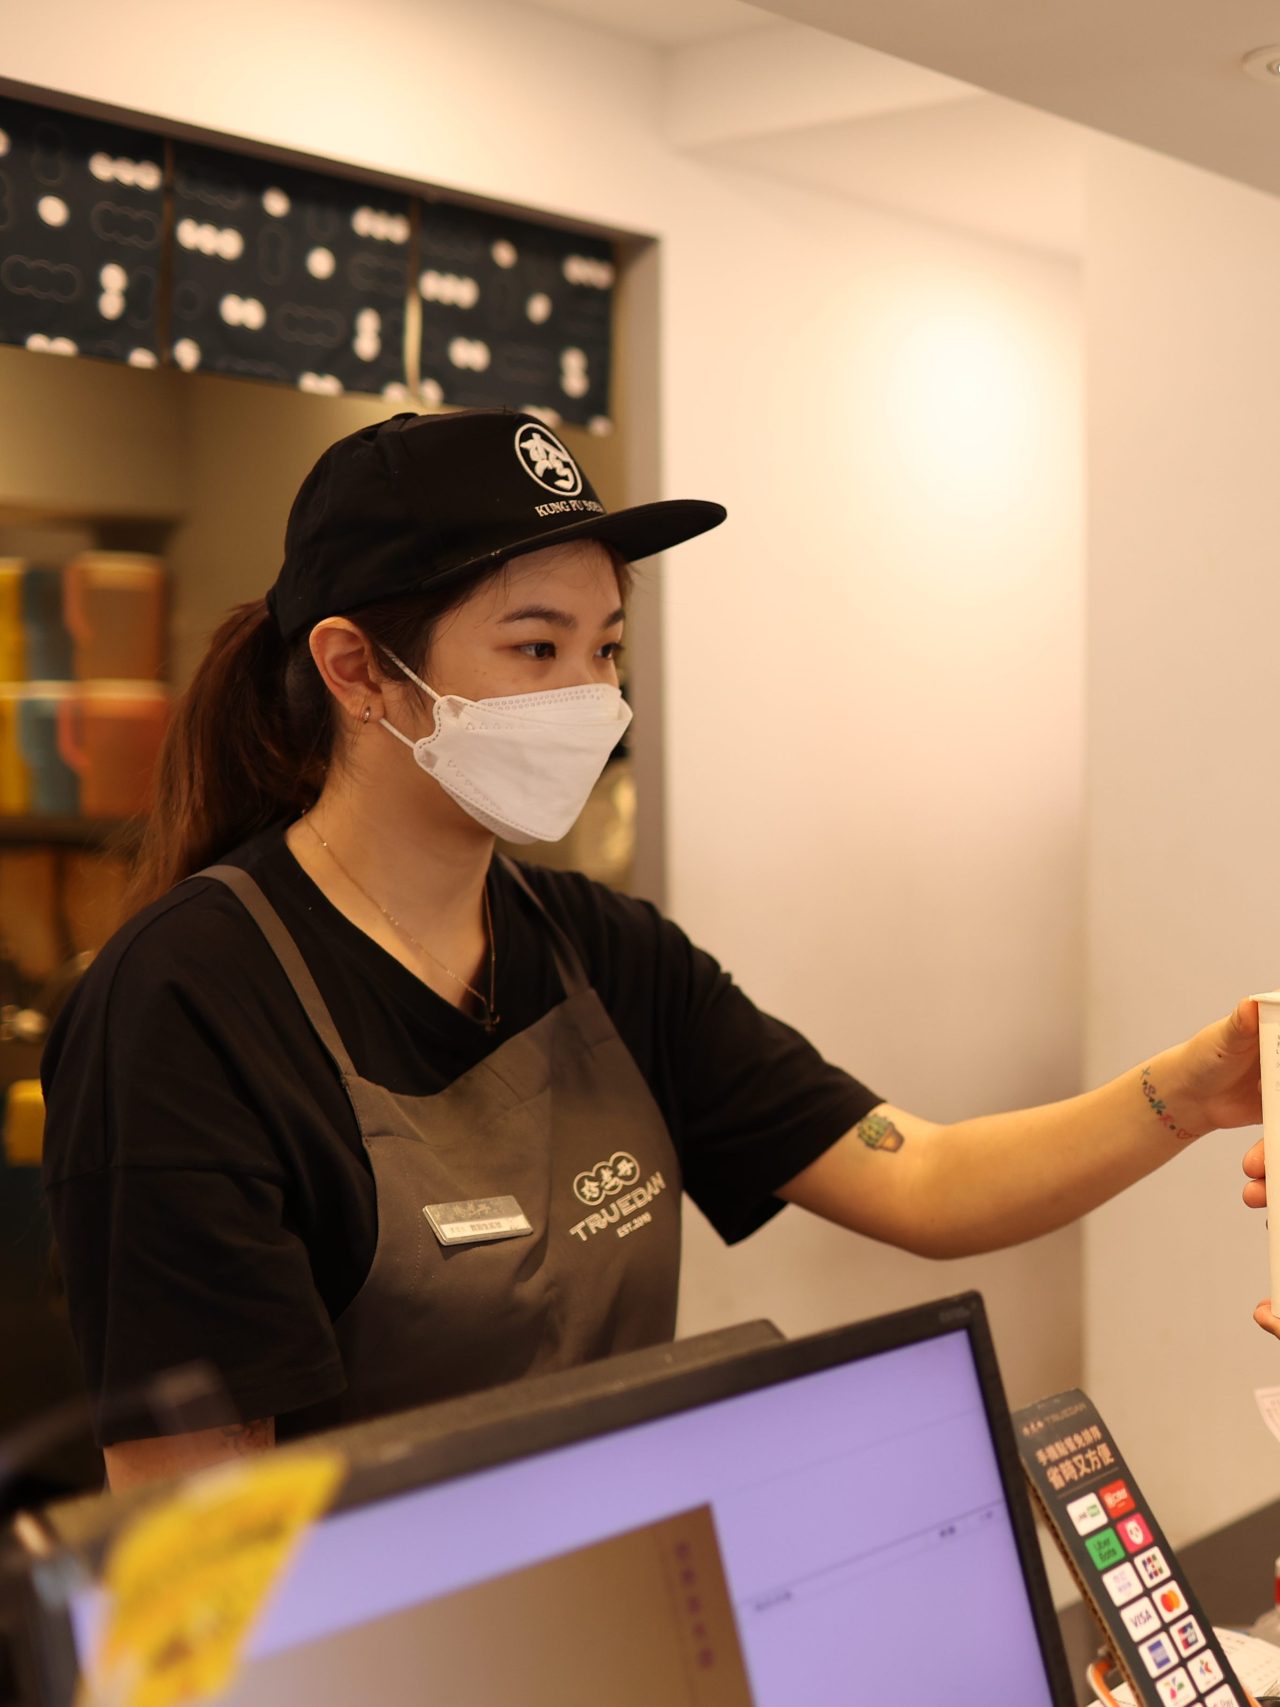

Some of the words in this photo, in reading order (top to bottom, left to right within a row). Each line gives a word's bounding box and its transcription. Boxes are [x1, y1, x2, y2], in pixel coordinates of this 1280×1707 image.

[535, 500, 571, 517] KUNG
[568, 1171, 666, 1242] TRUEDAN
[1130, 1609, 1153, 1628] VISA
